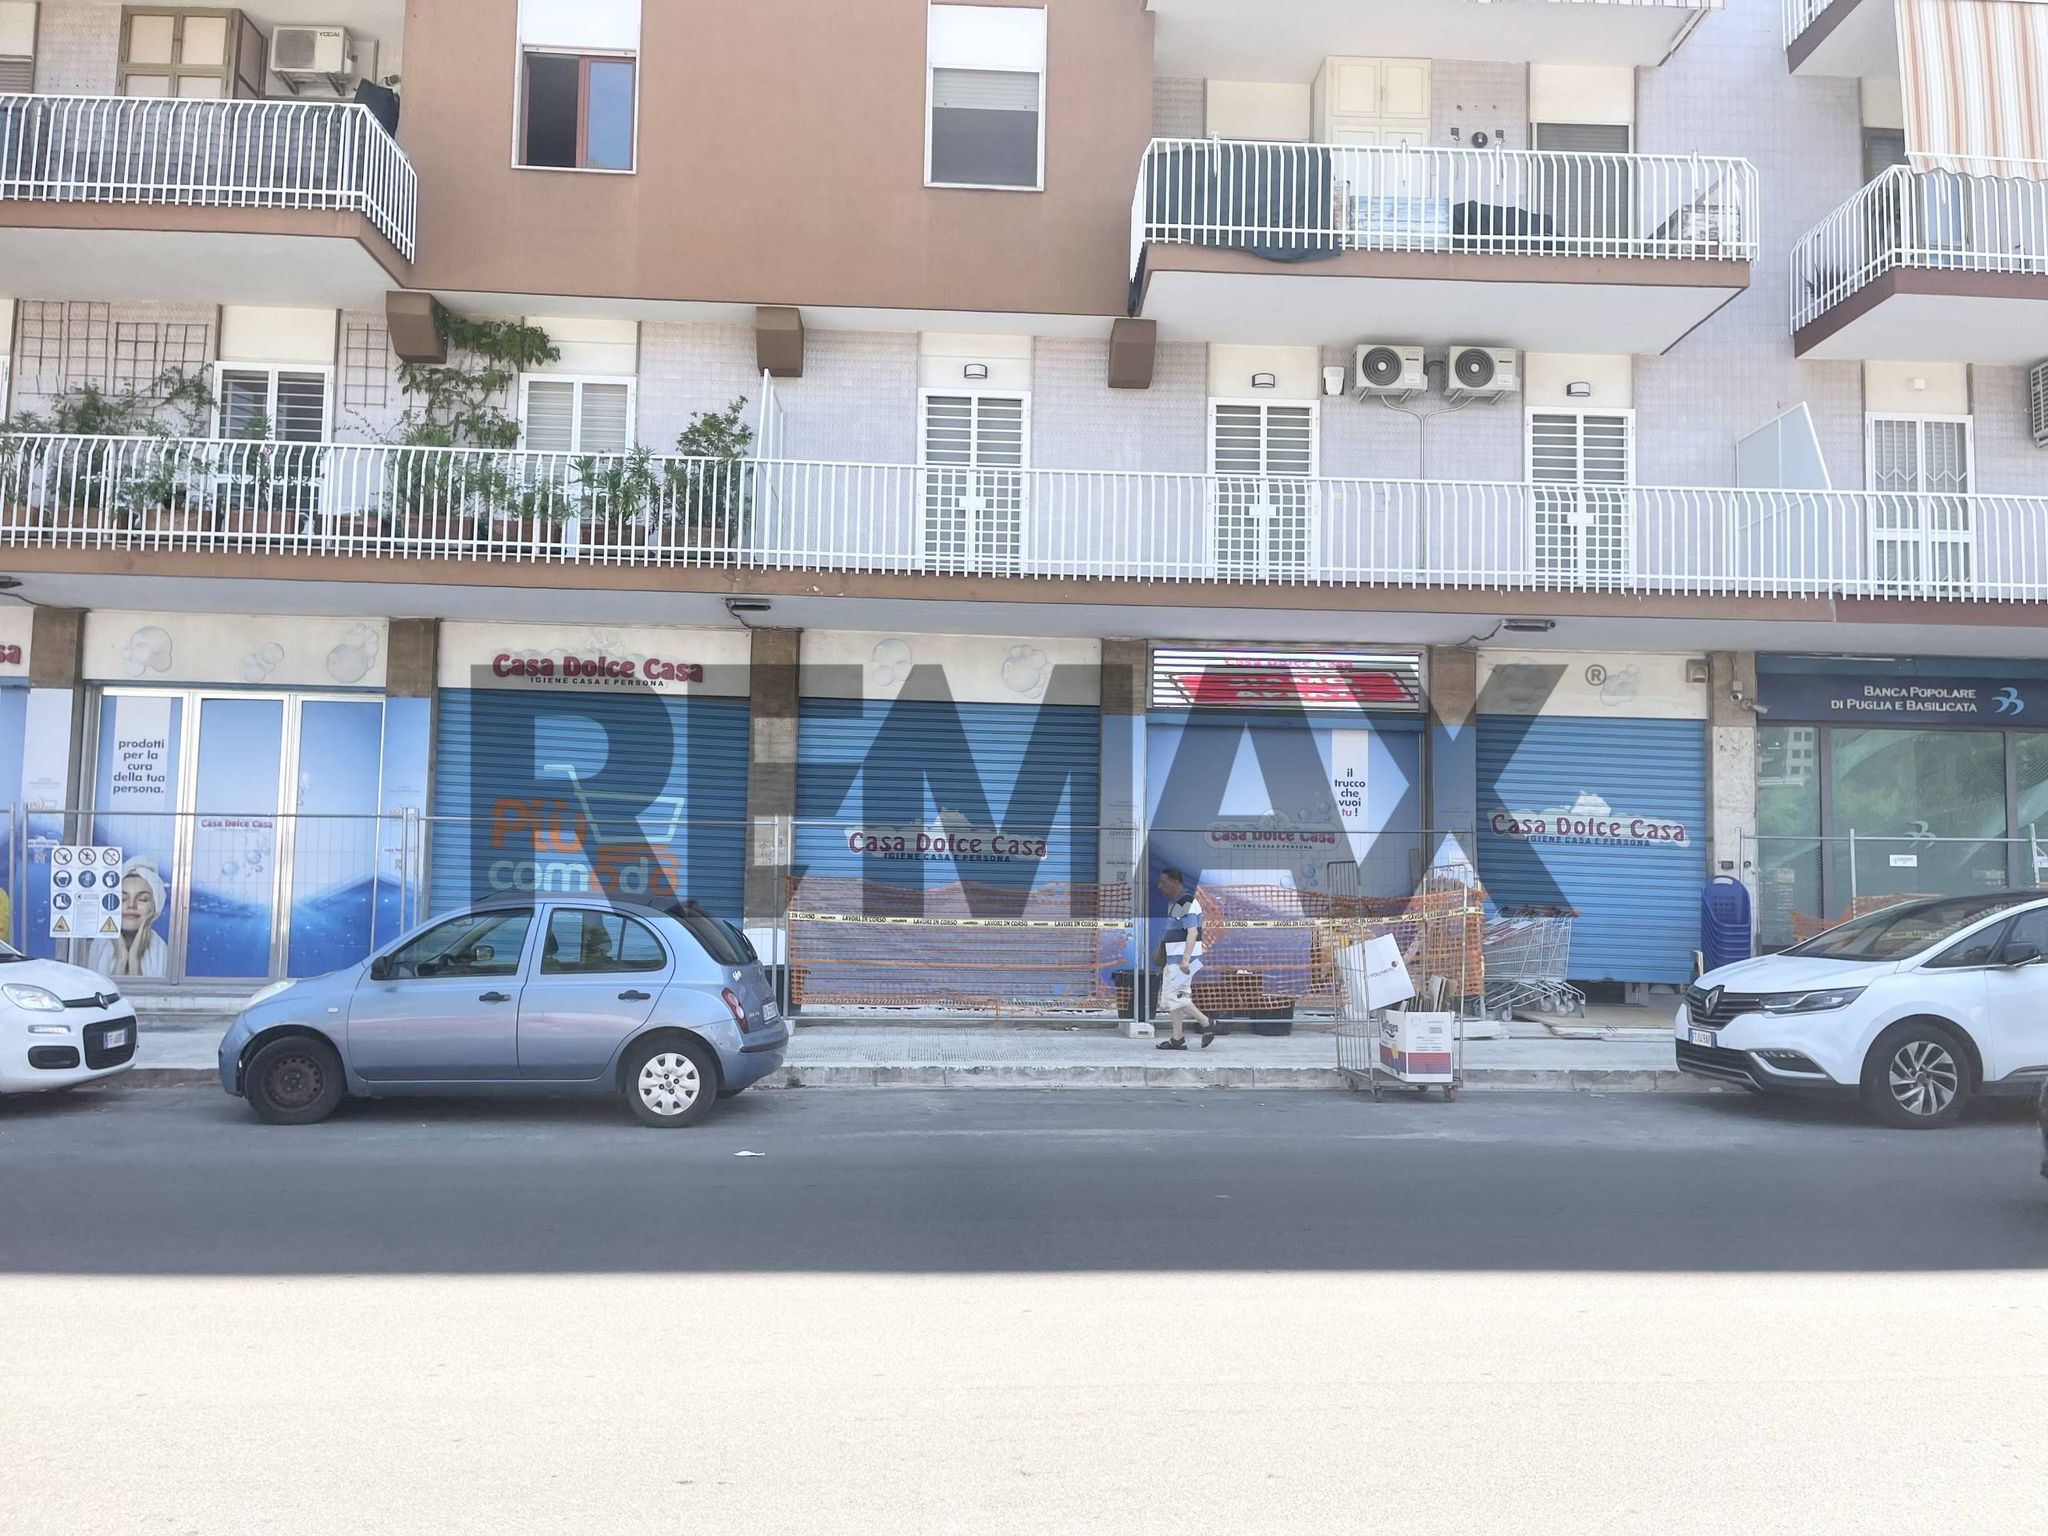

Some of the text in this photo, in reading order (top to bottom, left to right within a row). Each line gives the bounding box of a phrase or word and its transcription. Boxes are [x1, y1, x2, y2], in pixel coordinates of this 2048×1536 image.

[492, 653, 703, 682] Casa Dolce Casa
[530, 676, 569, 684] IGIENE
[572, 677, 600, 685] CASA
[613, 679, 664, 687] PERSONA
[1864, 685, 1977, 699] BANCA POPOLARE
[1847, 699, 1893, 711] PUGLIA
[1895, 701, 1903, 710] E
[1906, 700, 1978, 713] BASILICATA
[118, 738, 165, 750] prodotti
[123, 750, 158, 761] per la
[127, 763, 153, 771] cura
[1346, 768, 1353, 777] il
[113, 771, 165, 782] della tua
[1334, 779, 1366, 788] trucco
[113, 785, 165, 795] persona.
[1340, 788, 1360, 798] che
[1338, 797, 1362, 807] vuoi
[200, 819, 273, 829] Casa Dolce Casa
[1491, 813, 1685, 842] Casa Dolce Casa
[1211, 831, 1335, 844] Casa Dolce Casa
[1526, 835, 1650, 847] IGIENE CASA E PERSONA
[848, 832, 1047, 857] Casa Dolce Casa
[884, 852, 921, 860] IGIENE
[924, 853, 950, 861] CASA
[962, 854, 1010, 863] PERSONA
[488, 856, 680, 896] comodo
